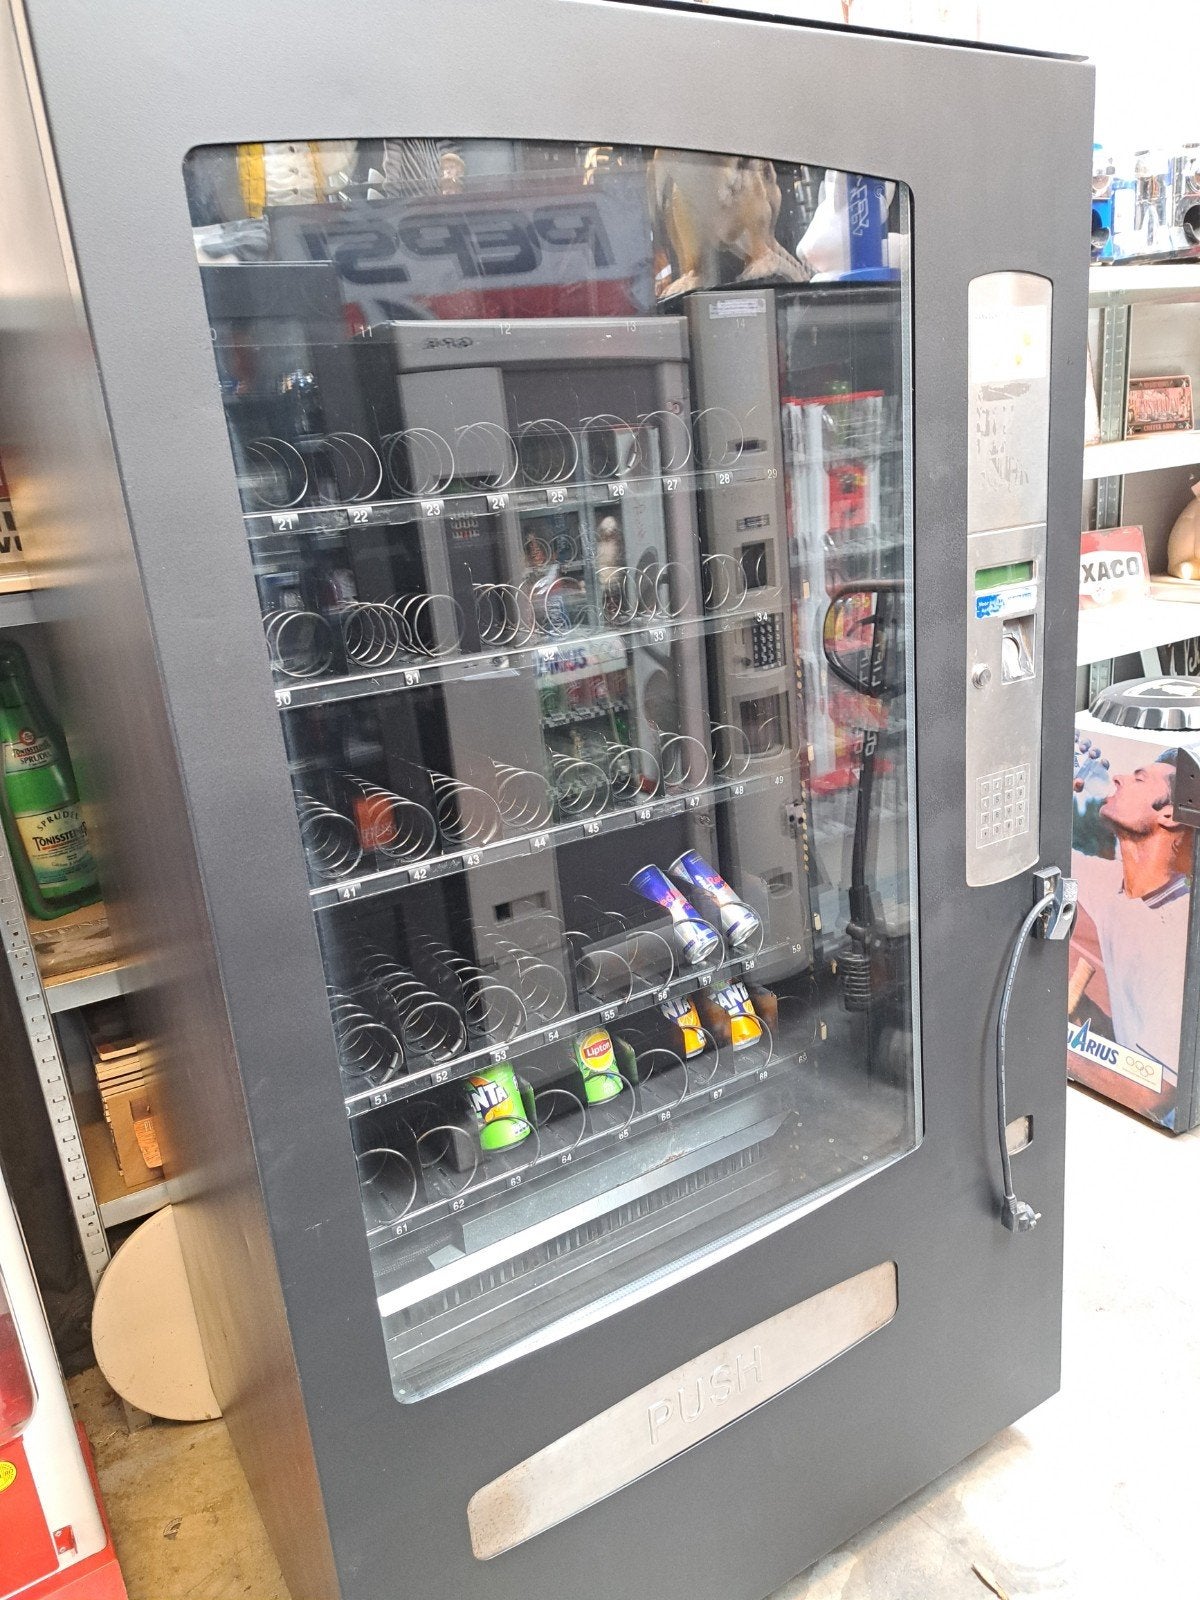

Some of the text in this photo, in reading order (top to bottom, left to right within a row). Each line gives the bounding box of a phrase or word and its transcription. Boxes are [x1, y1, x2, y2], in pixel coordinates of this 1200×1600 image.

[360, 325, 372, 338] 11
[499, 323, 512, 335] 12
[625, 321, 637, 333] 13
[736, 318, 746, 329] 14
[278, 468, 778, 531] 21 22 23 24 25 26 27 28 29
[1081, 556, 1140, 584] XACO
[405, 673, 420, 686] 31
[543, 651, 555, 662] 32
[654, 631, 664, 642] 33
[756, 611, 768, 622] 34
[37, 810, 80, 833] SPRUDEL
[343, 775, 784, 899] 41 42 43 44 45 46 47 48 49
[374, 1092, 388, 1106] 51
[436, 1071, 449, 1084] 52
[495, 1051, 507, 1063] 53
[548, 1030, 560, 1041] 54
[604, 1009, 616, 1020] 55
[657, 991, 668, 1002] 56
[702, 975, 712, 987] 57
[745, 960, 755, 971] 58
[792, 944, 802, 955] 59
[586, 1042, 611, 1057] Lipton
[470, 1081, 508, 1113] NTA
[396, 1225, 409, 1236] 61
[453, 1198, 465, 1210] 62
[510, 1175, 522, 1187] 63
[561, 1153, 572, 1164] 64
[618, 1129, 629, 1140] 65
[713, 1089, 723, 1100] 67
[648, 1345, 762, 1446] PUSH
